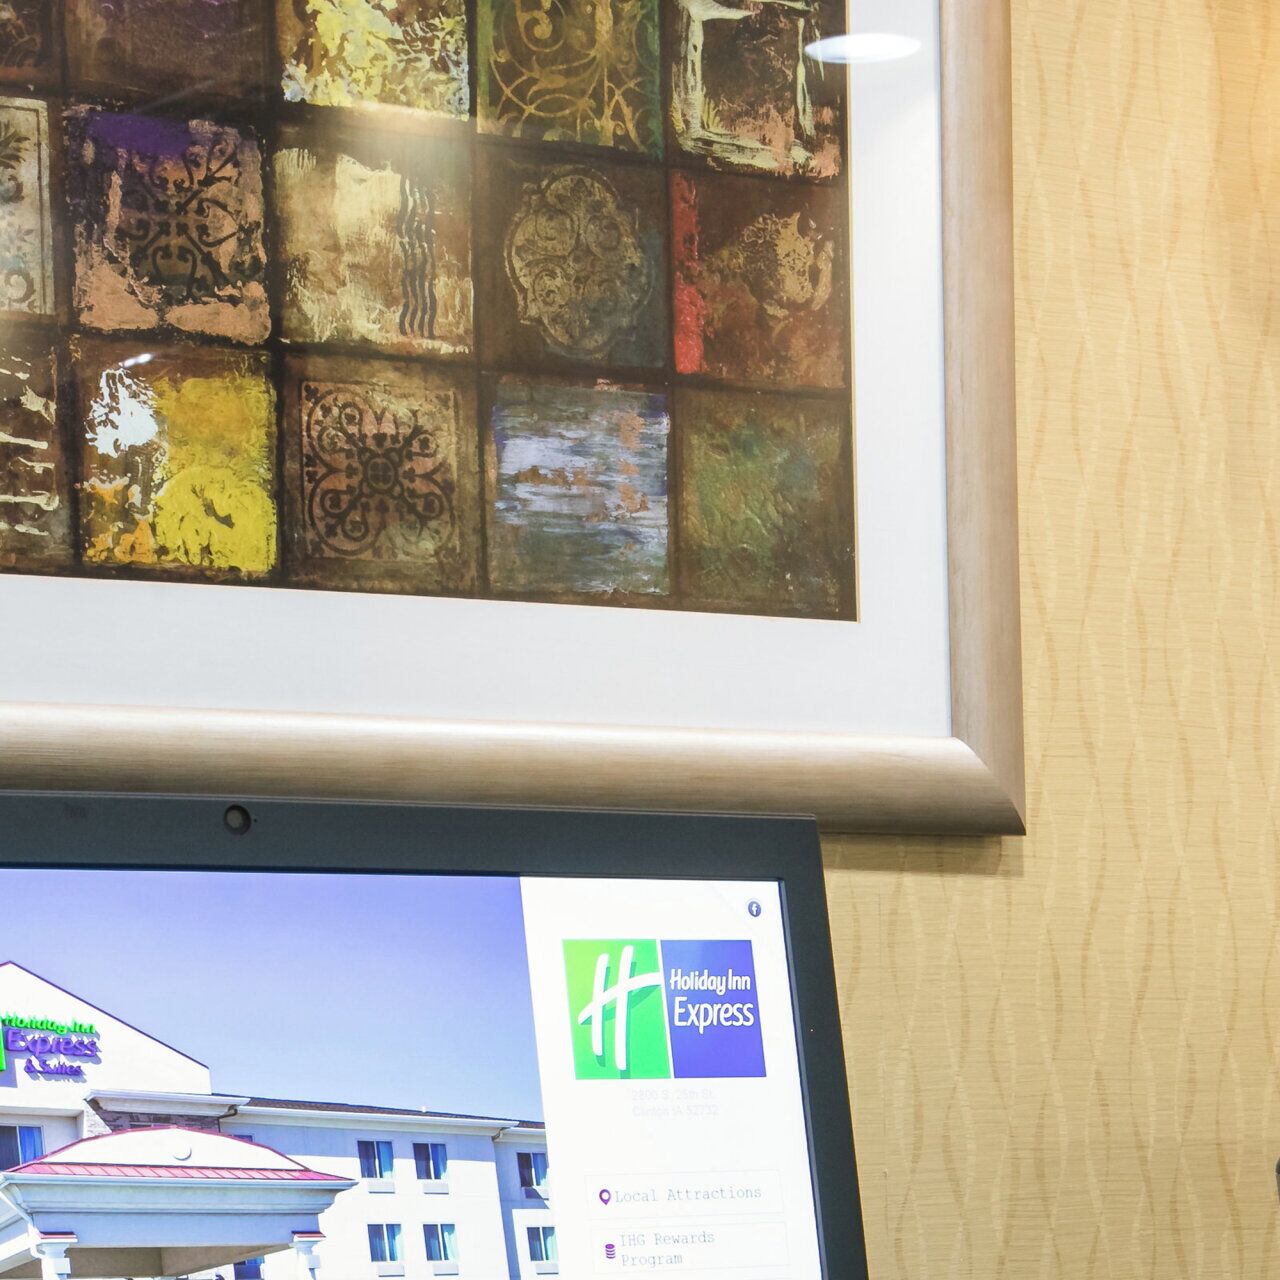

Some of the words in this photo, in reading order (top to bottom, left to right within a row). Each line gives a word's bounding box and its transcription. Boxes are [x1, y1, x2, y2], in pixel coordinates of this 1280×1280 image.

[670, 968, 727, 996] Holiday
[727, 968, 751, 991] Inn
[4, 1011, 68, 1035] Holiday
[70, 1017, 97, 1034] Inn
[673, 996, 755, 1035] Express
[6, 1029, 98, 1057] Express
[614, 1189, 657, 1204] Local
[667, 1186, 762, 1202] Attractions
[621, 1234, 646, 1247] IHG
[654, 1231, 716, 1246] Rewards
[621, 1253, 684, 1269] Program
